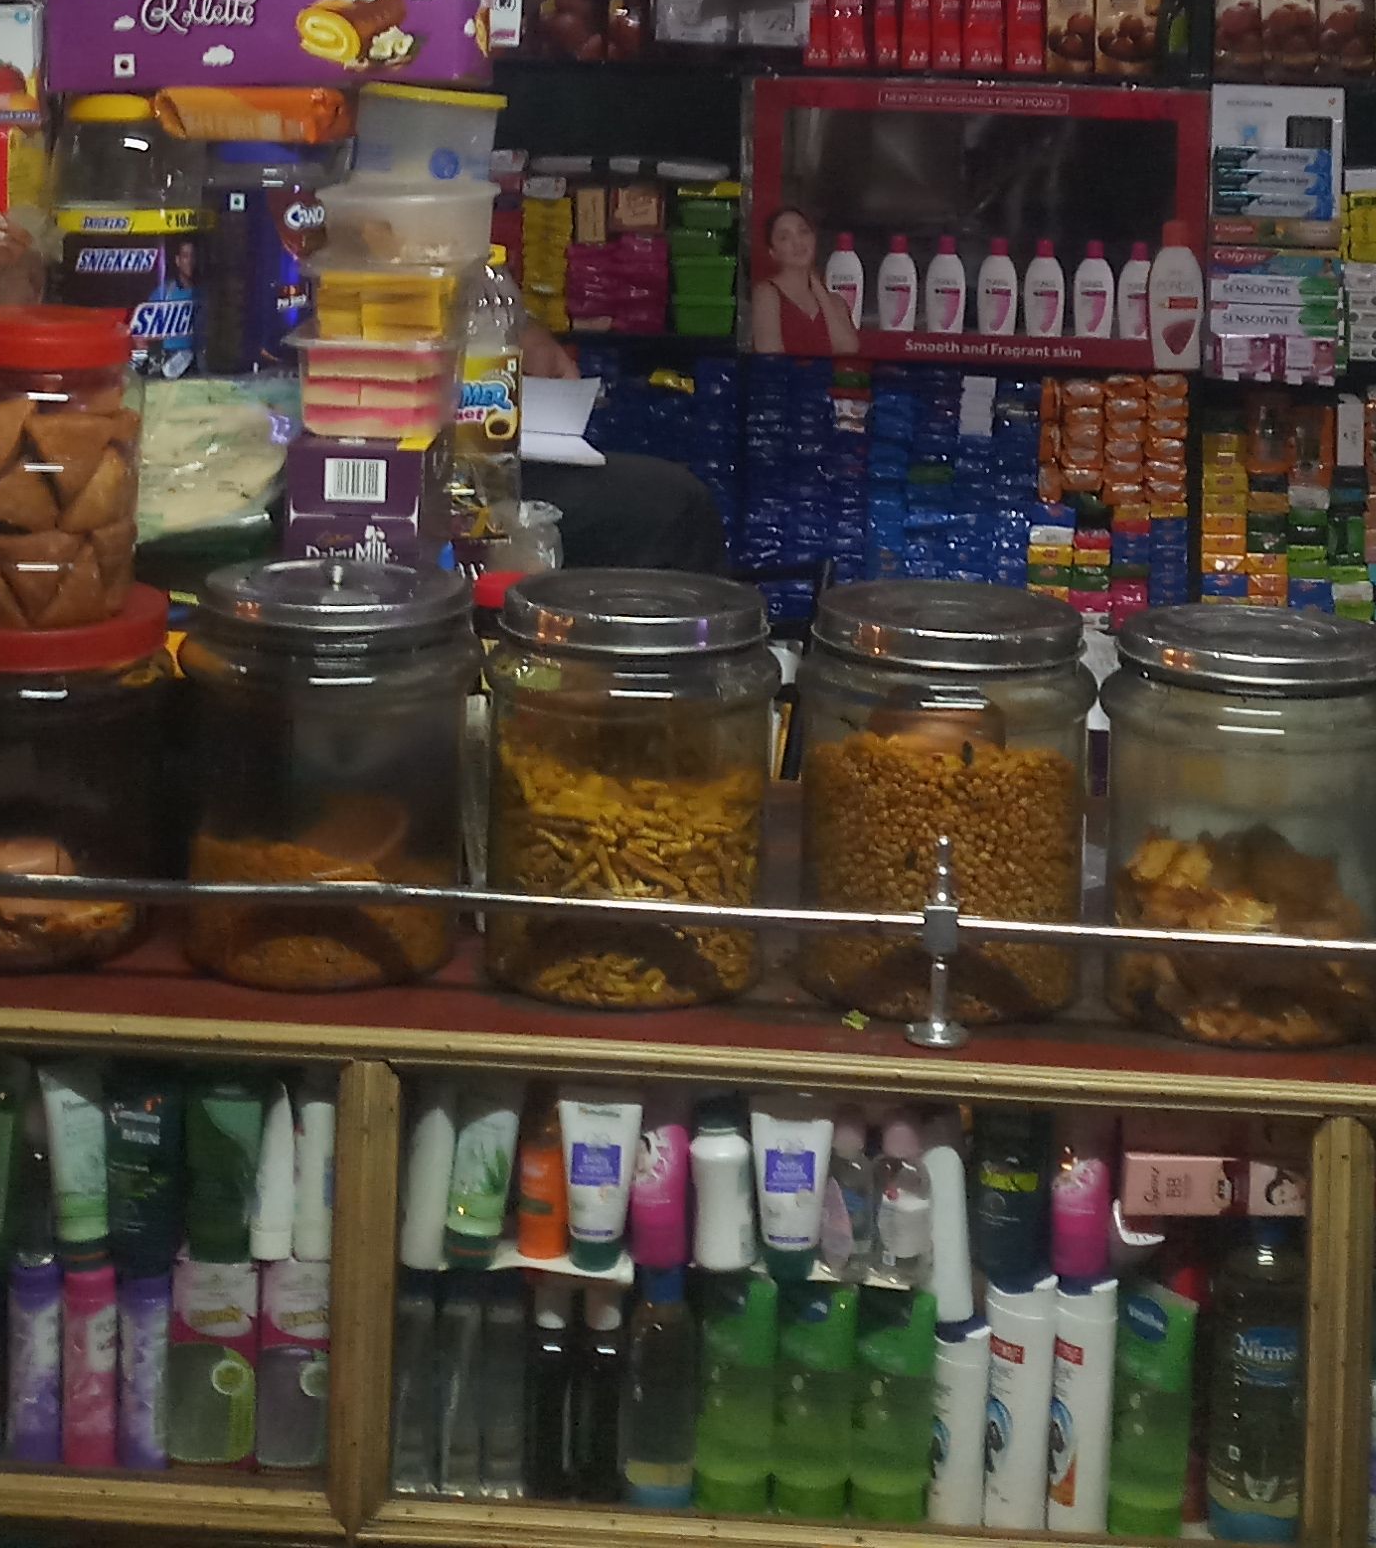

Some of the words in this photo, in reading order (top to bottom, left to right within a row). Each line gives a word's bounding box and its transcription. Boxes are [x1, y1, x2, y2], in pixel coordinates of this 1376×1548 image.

[75, 247, 159, 273] SNICKERS
[1214, 250, 1268, 264] Colgate
[1223, 283, 1291, 296] SENSODYNE
[130, 300, 197, 338] SNIC
[1223, 313, 1289, 326] SENSODYNE
[905, 338, 960, 354] Smooth
[961, 341, 989, 355] and
[990, 342, 1051, 359] Fragrant
[1053, 344, 1082, 359] skin
